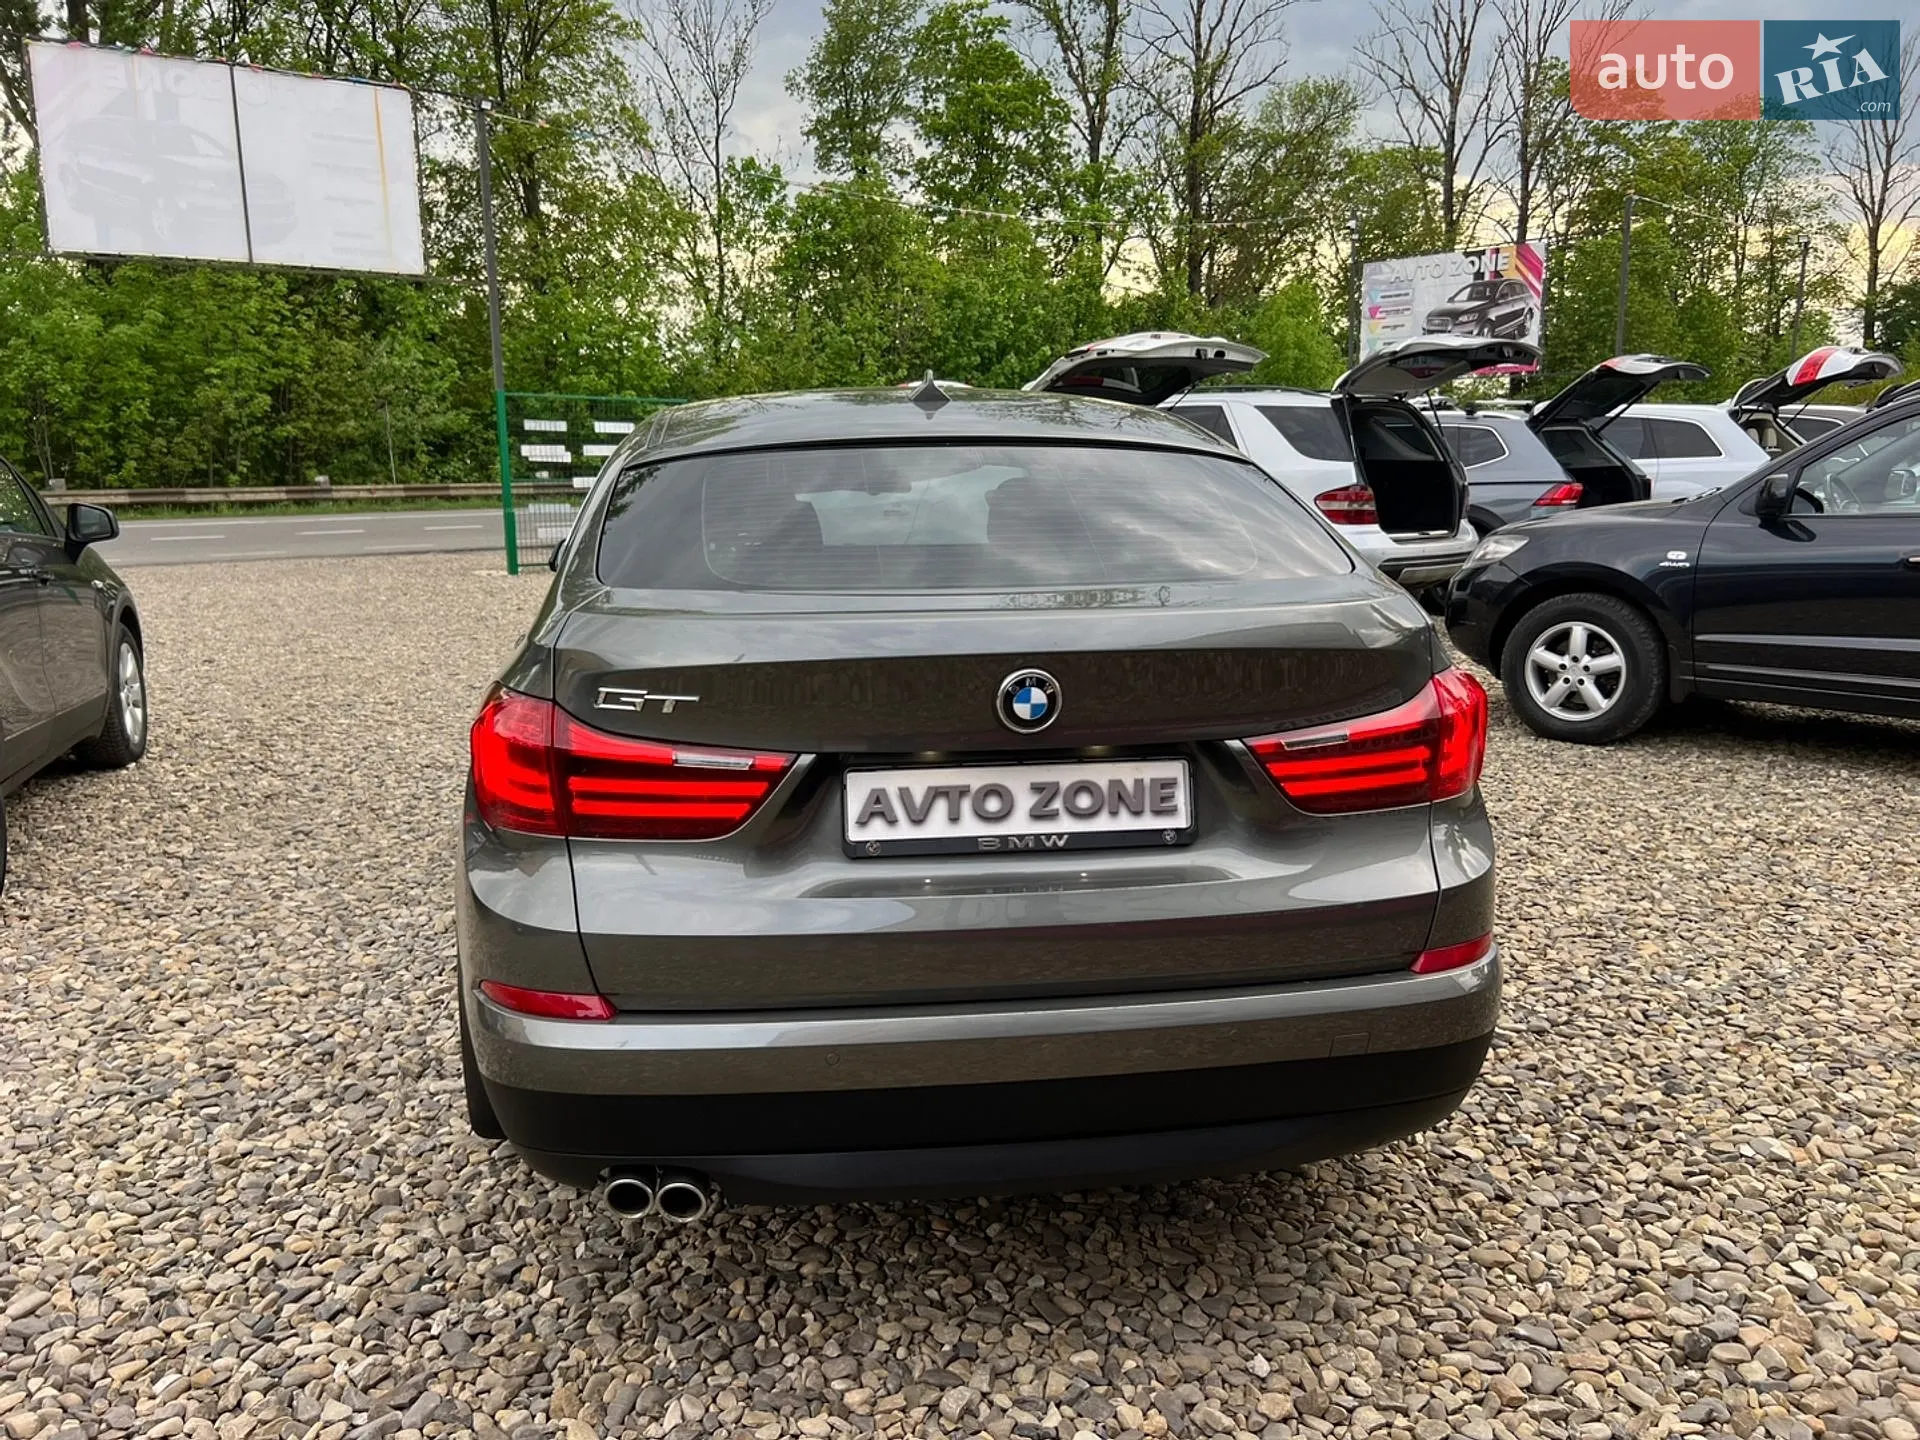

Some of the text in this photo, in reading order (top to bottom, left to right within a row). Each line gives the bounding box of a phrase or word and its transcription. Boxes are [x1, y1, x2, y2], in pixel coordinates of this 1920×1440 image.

[1389, 251, 1512, 285] AVTO ZONE
[593, 687, 700, 714] GT
[855, 776, 1179, 826] AVTO ZONE
[976, 834, 1070, 850] BMW
